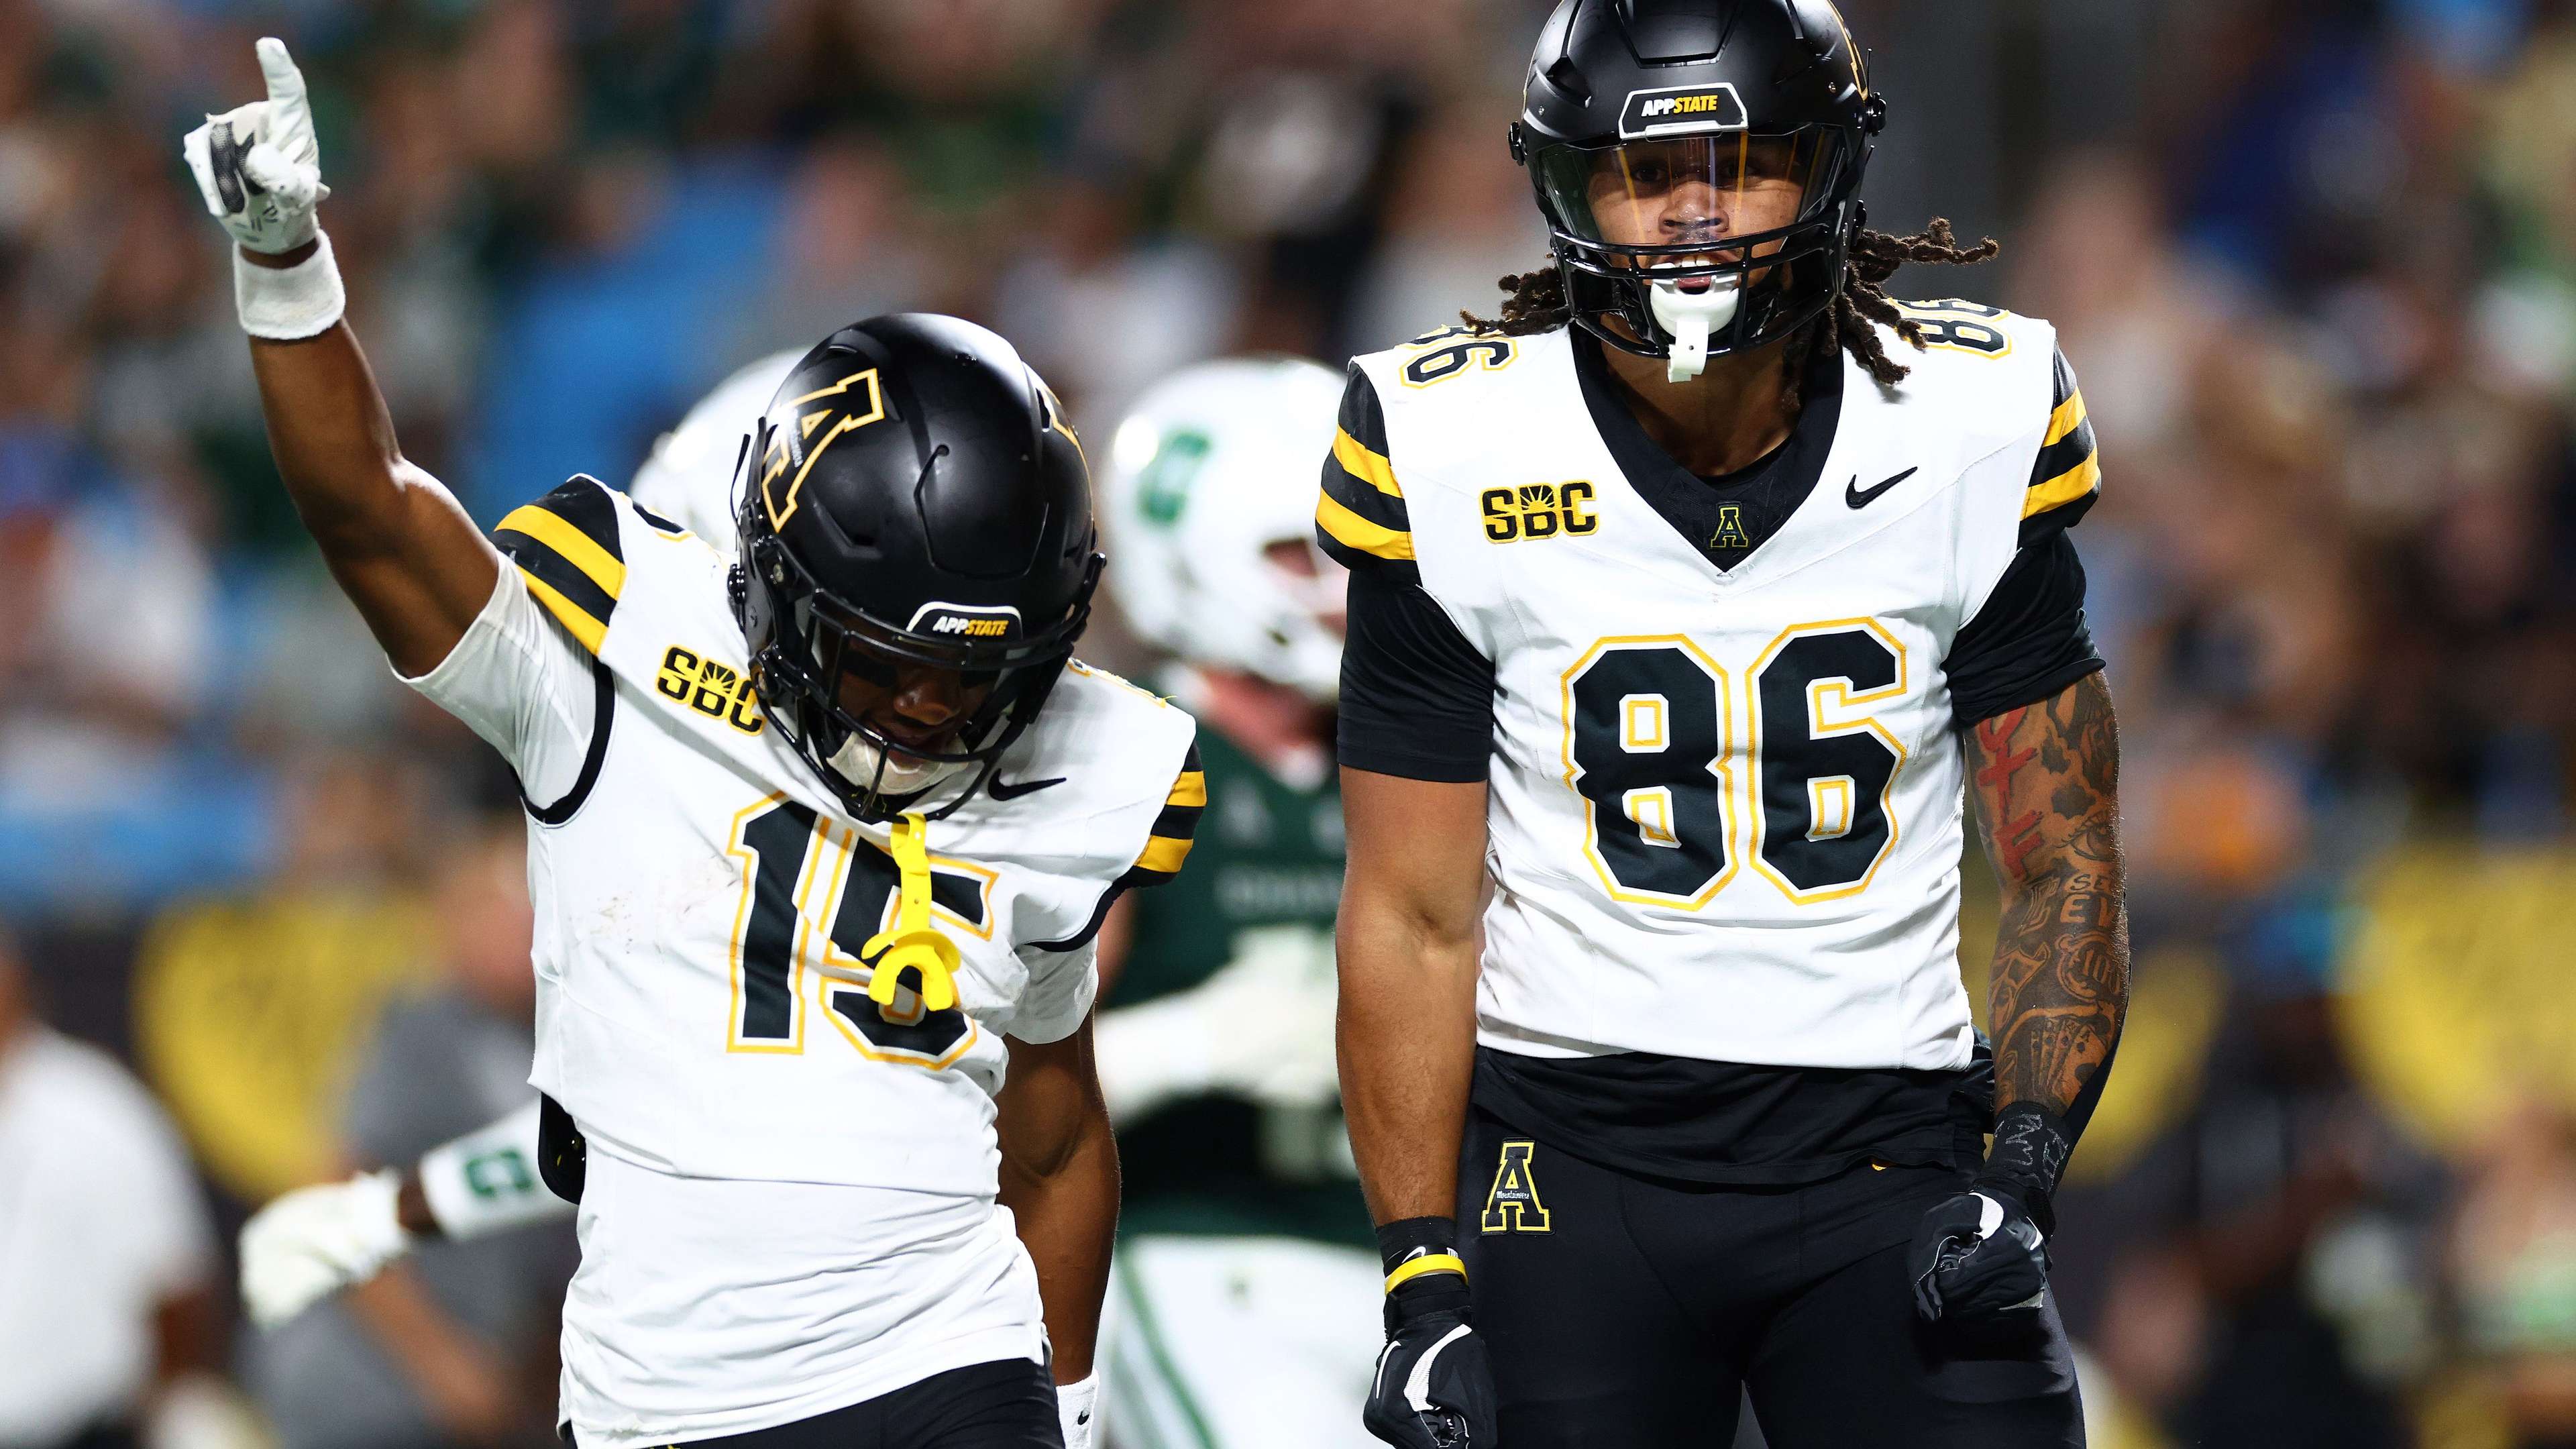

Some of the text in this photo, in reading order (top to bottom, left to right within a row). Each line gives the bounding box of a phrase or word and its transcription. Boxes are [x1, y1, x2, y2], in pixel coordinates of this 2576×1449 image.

[1641, 95, 1718, 117] APPSTATE
[1479, 479, 1599, 544] SBC
[1711, 506, 1748, 547] A
[932, 616, 1009, 636] APPSTATE
[656, 644, 767, 737] SBC
[1560, 616, 1907, 912] 86
[727, 790, 1000, 1069] 15
[1481, 1142, 1551, 1232] A
